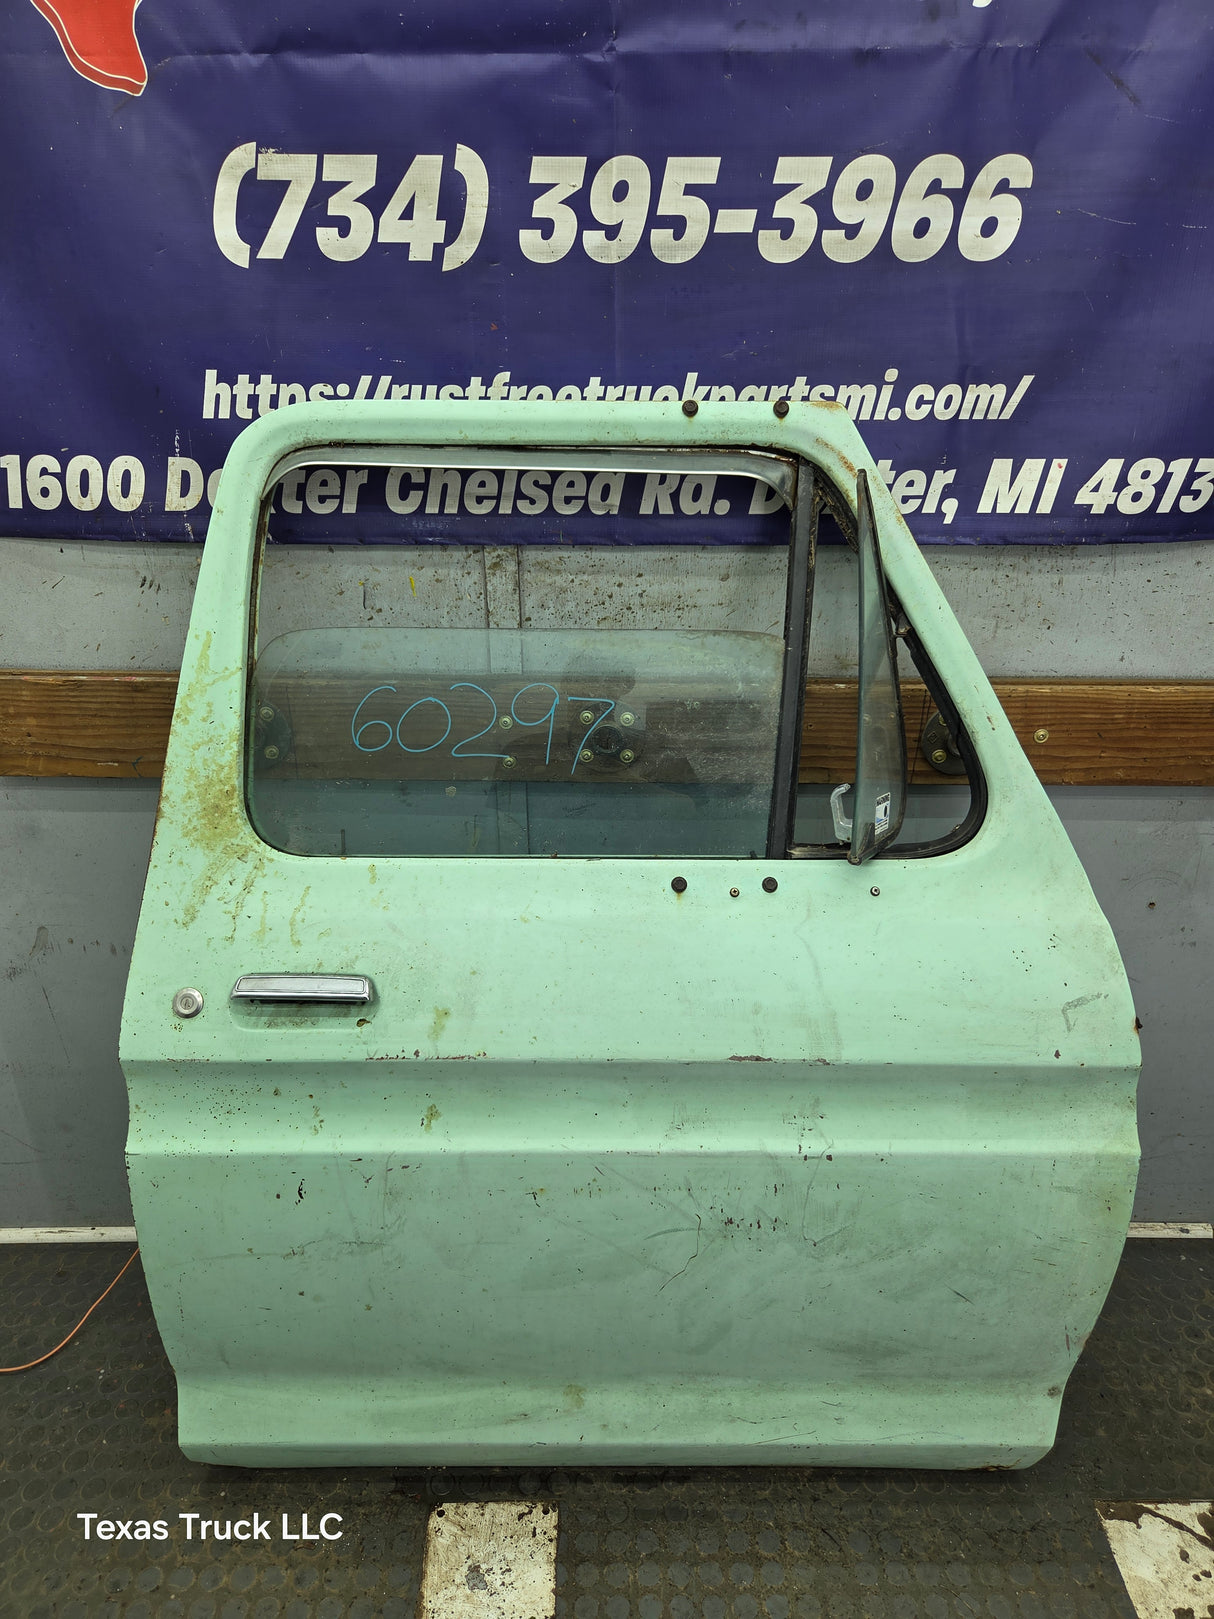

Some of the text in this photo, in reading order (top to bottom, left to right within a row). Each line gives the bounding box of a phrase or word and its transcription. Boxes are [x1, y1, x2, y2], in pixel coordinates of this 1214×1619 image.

[213, 142, 1033, 271] (734) 395-3966
[0, 454, 145, 511] 1600
[165, 456, 367, 514] Dter
[976, 458, 1068, 514] MI
[1074, 457, 1214, 515] 4813
[352, 683, 615, 774] 60297
